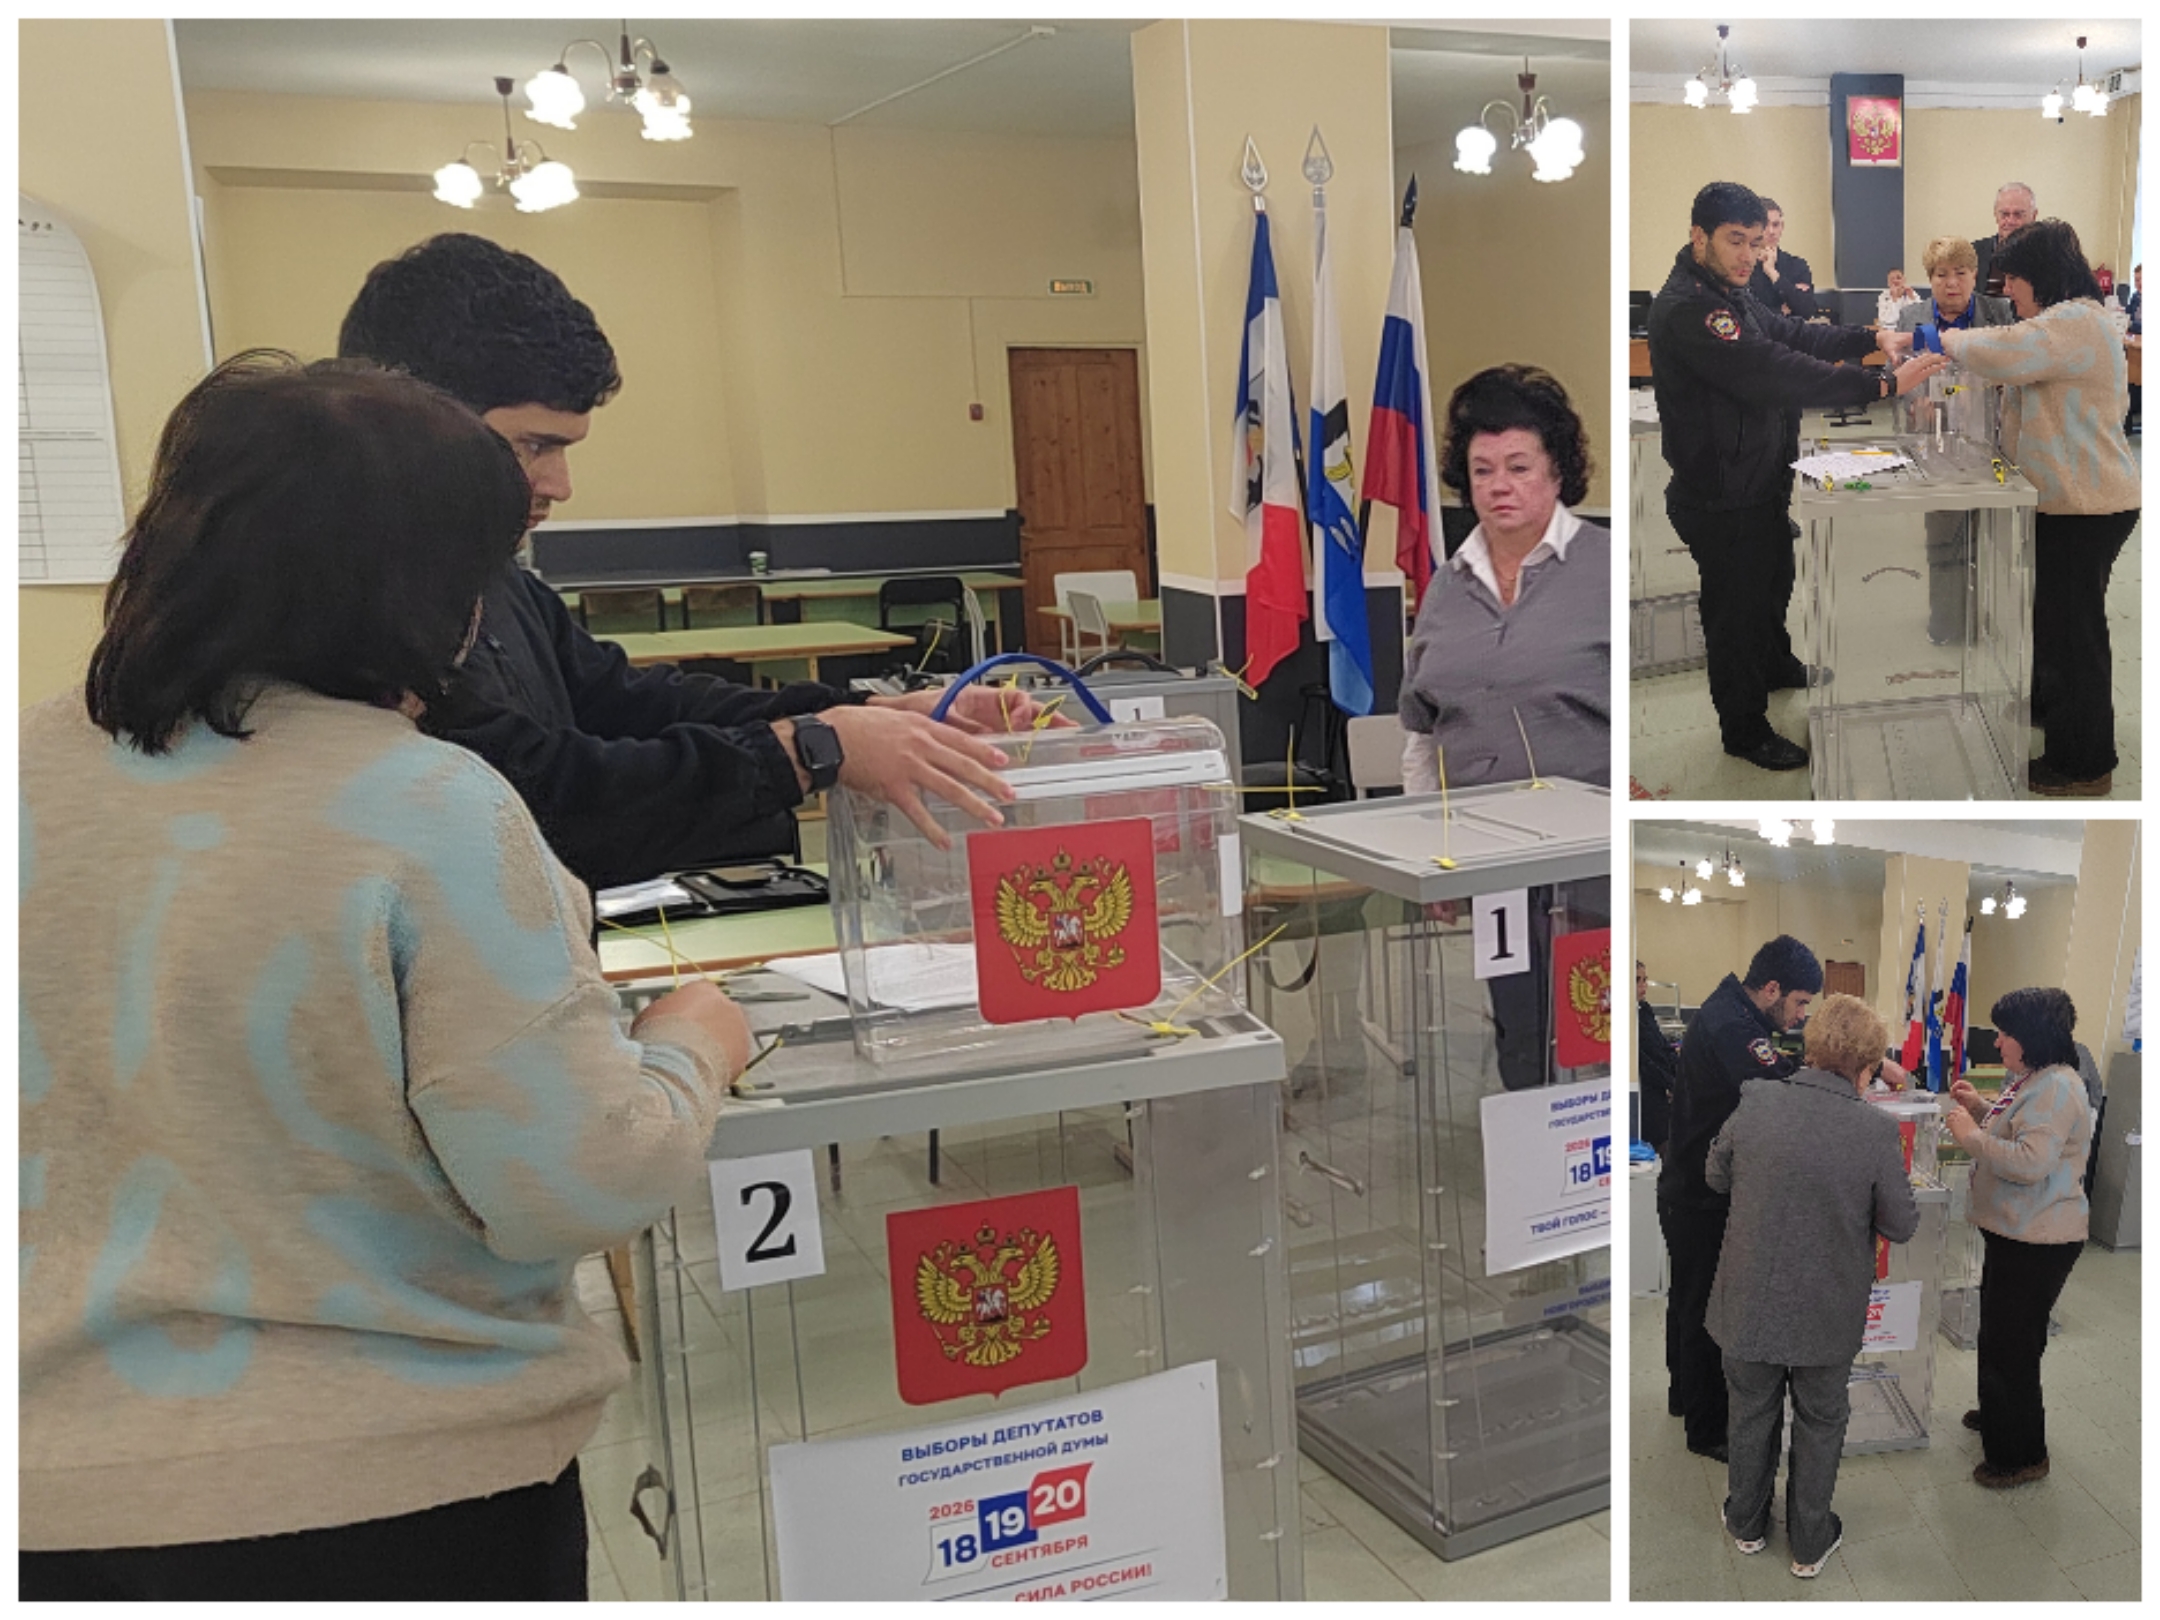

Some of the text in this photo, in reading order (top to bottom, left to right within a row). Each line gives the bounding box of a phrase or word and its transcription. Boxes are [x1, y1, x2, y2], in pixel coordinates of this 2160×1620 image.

[1490, 906, 1515, 961] 1
[1550, 1092, 1598, 1113] ВЫБОРЫ
[1565, 1138, 1590, 1152] 2026
[1569, 1162, 1591, 1184] 18
[741, 1181, 796, 1263] 2
[1530, 1216, 1561, 1235] ТВОЙ
[1562, 1209, 1598, 1227] ГОЛОС
[901, 1409, 1104, 1462] ВЫБОРЫ ДЕПУТАТОВ
[898, 1433, 1109, 1487] ГОСУДАРСТВЕННОЙ ДУМЫ
[929, 1500, 975, 1520] 2026
[937, 1479, 1082, 1568] 18 19 20
[992, 1534, 1089, 1569] СЕНТЯБРЯ
[1015, 1563, 1153, 1601] СИЛА РОССИИ!
